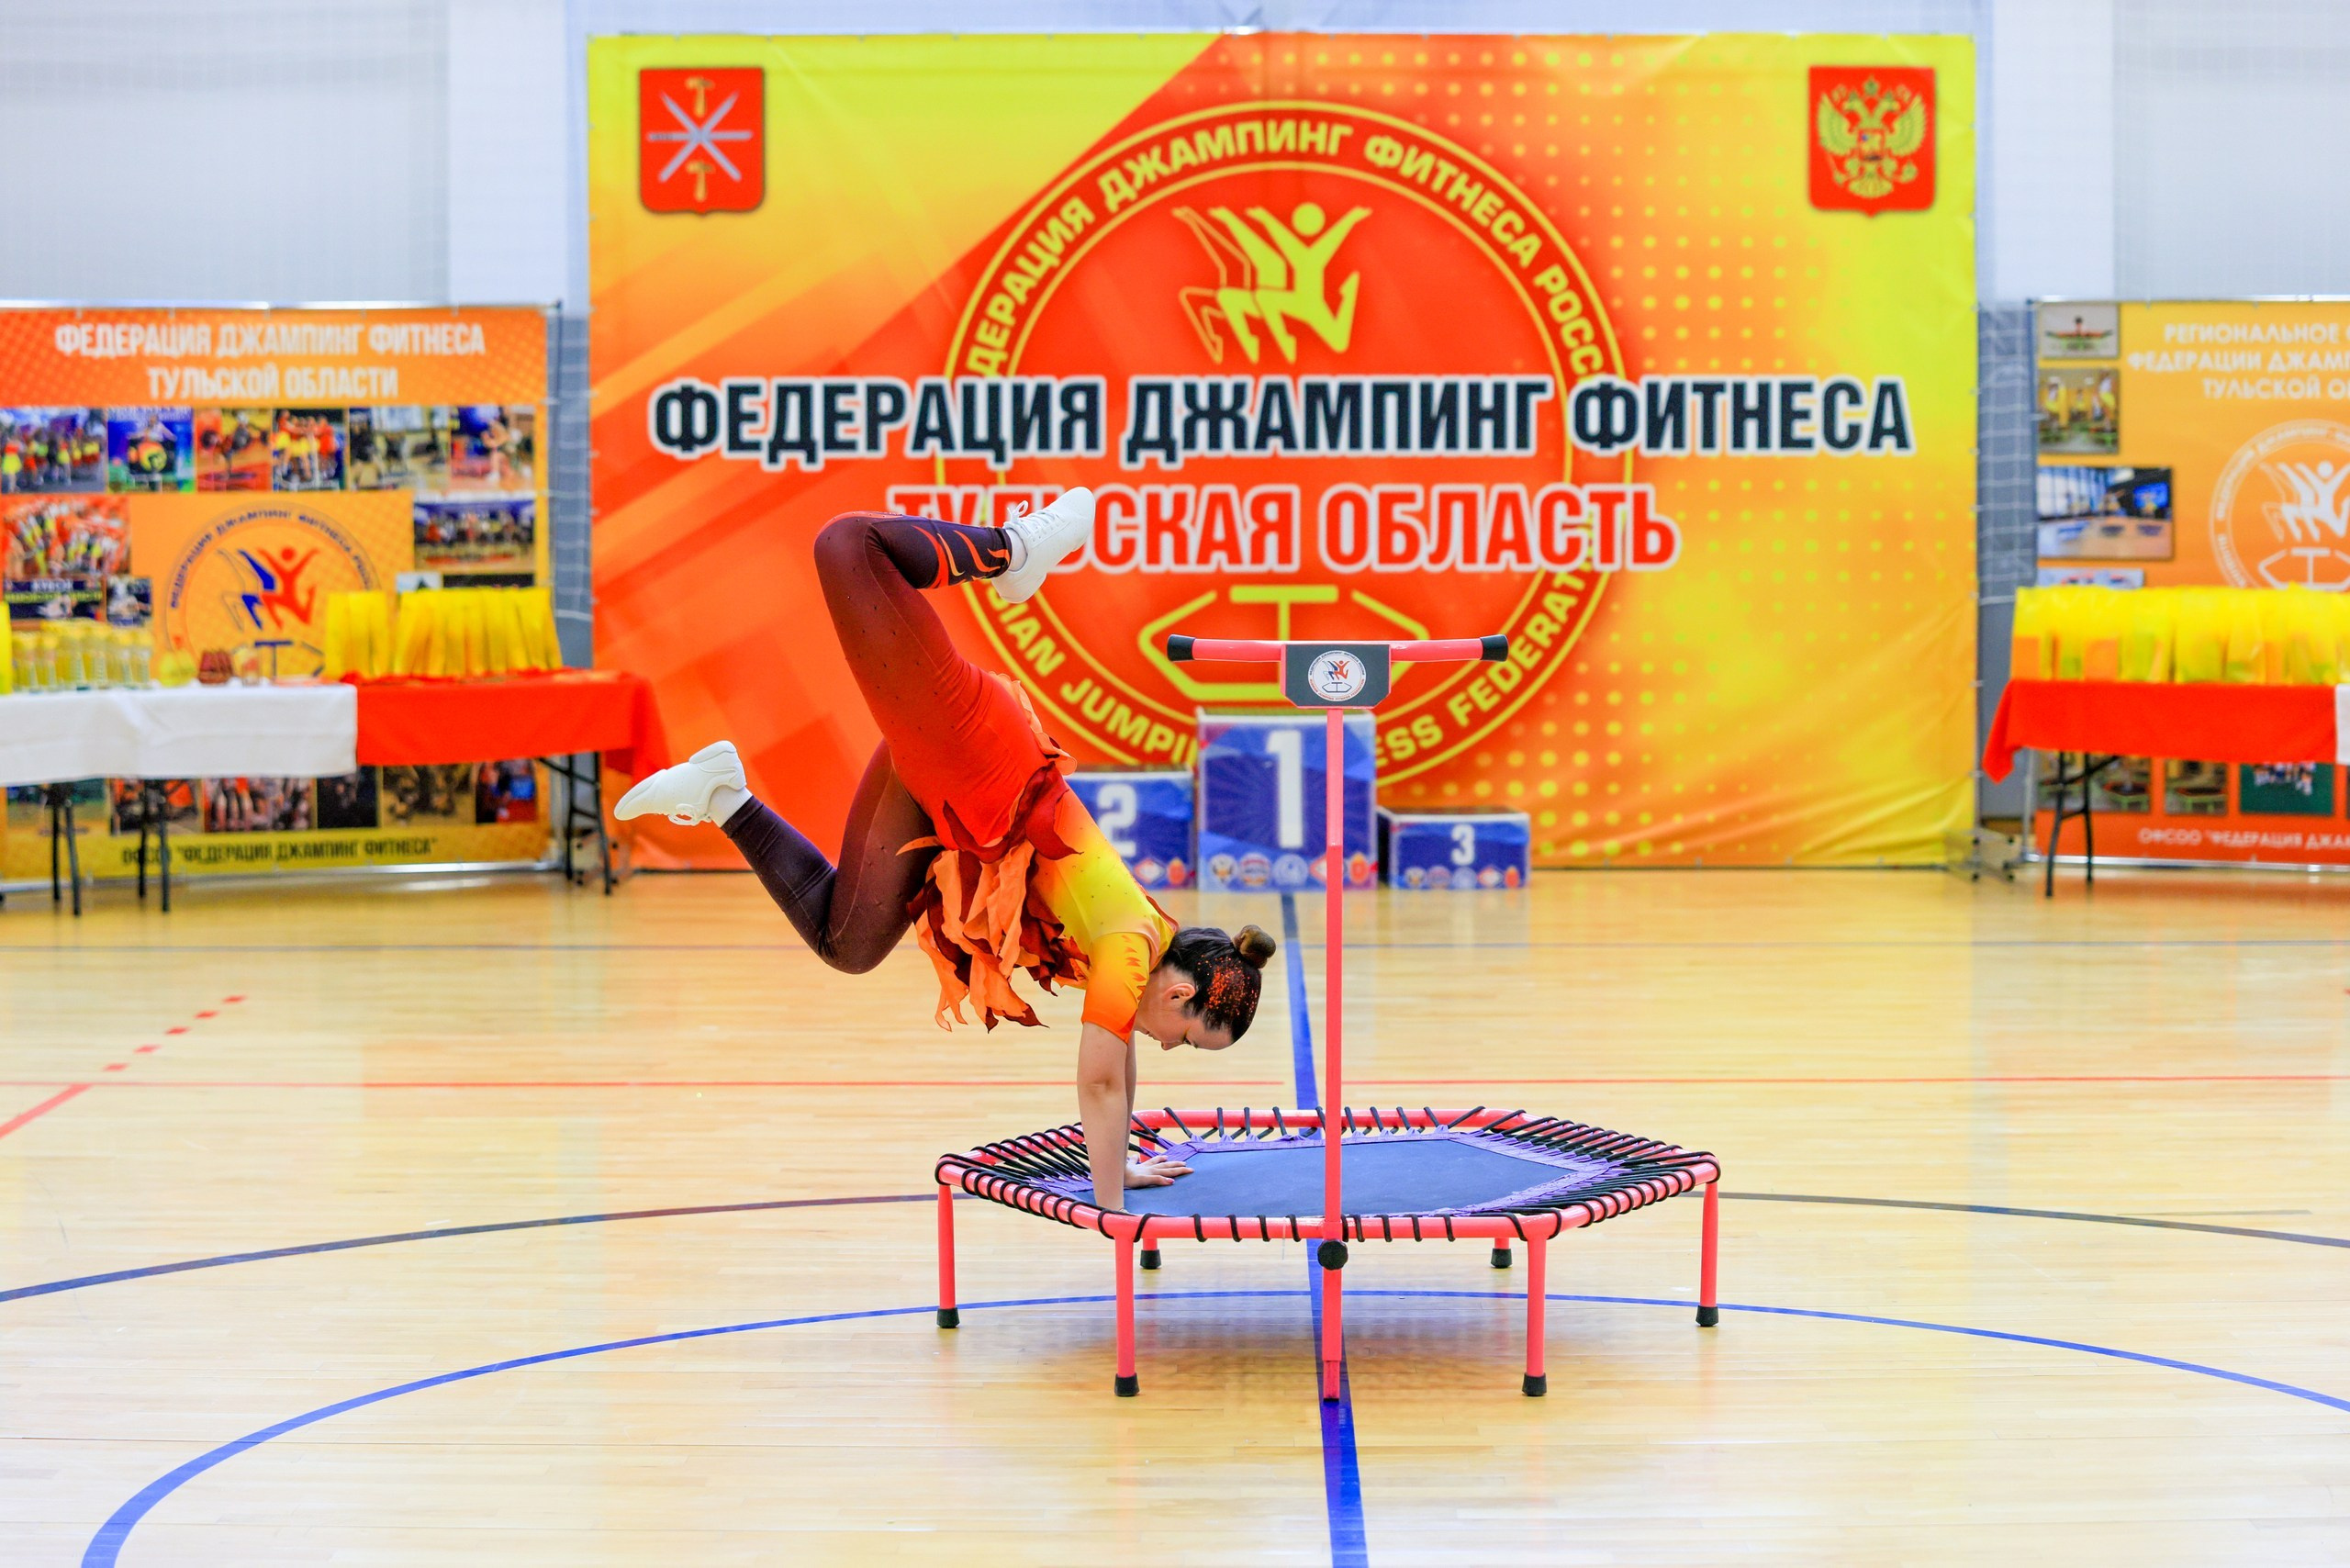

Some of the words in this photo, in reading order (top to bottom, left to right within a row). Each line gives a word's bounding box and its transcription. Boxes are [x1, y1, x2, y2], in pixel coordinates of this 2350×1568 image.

[966, 196, 1096, 378] ДЕРАЦИЯ
[1097, 118, 1353, 213] ДЖАМПИНГ
[1363, 135, 1543, 269] ФИТНЕСА
[1533, 263, 1605, 382] РОСС
[54, 322, 212, 357] ФЕДЕРАЦИЯ
[216, 324, 365, 357] ДЖАМПИНГ
[369, 324, 486, 355] ФИТНЕСА
[2126, 350, 2261, 374] ФЕДЕРАЦИИ
[2163, 321, 2340, 344] РЕГИОНАЛЬНОЕ
[146, 362, 280, 400] ТУЛЬСКОЙ
[285, 367, 398, 398] ОБЛАСТИ
[2202, 375, 2322, 399] ТУЛЬСКОЙ
[652, 379, 1104, 466] ФЕДЕРАЦИЯ
[1122, 378, 1553, 466] ДЖАМПИНГ
[1571, 377, 1915, 453] ФИТНЕСА
[1322, 487, 1679, 570] ОБЛАСТЬ
[1060, 678, 1198, 767] JUMPI
[1447, 564, 1593, 727] FEDERAT
[1264, 729, 1304, 849] 1
[1095, 782, 1137, 858] 2
[1449, 823, 1476, 867] 3
